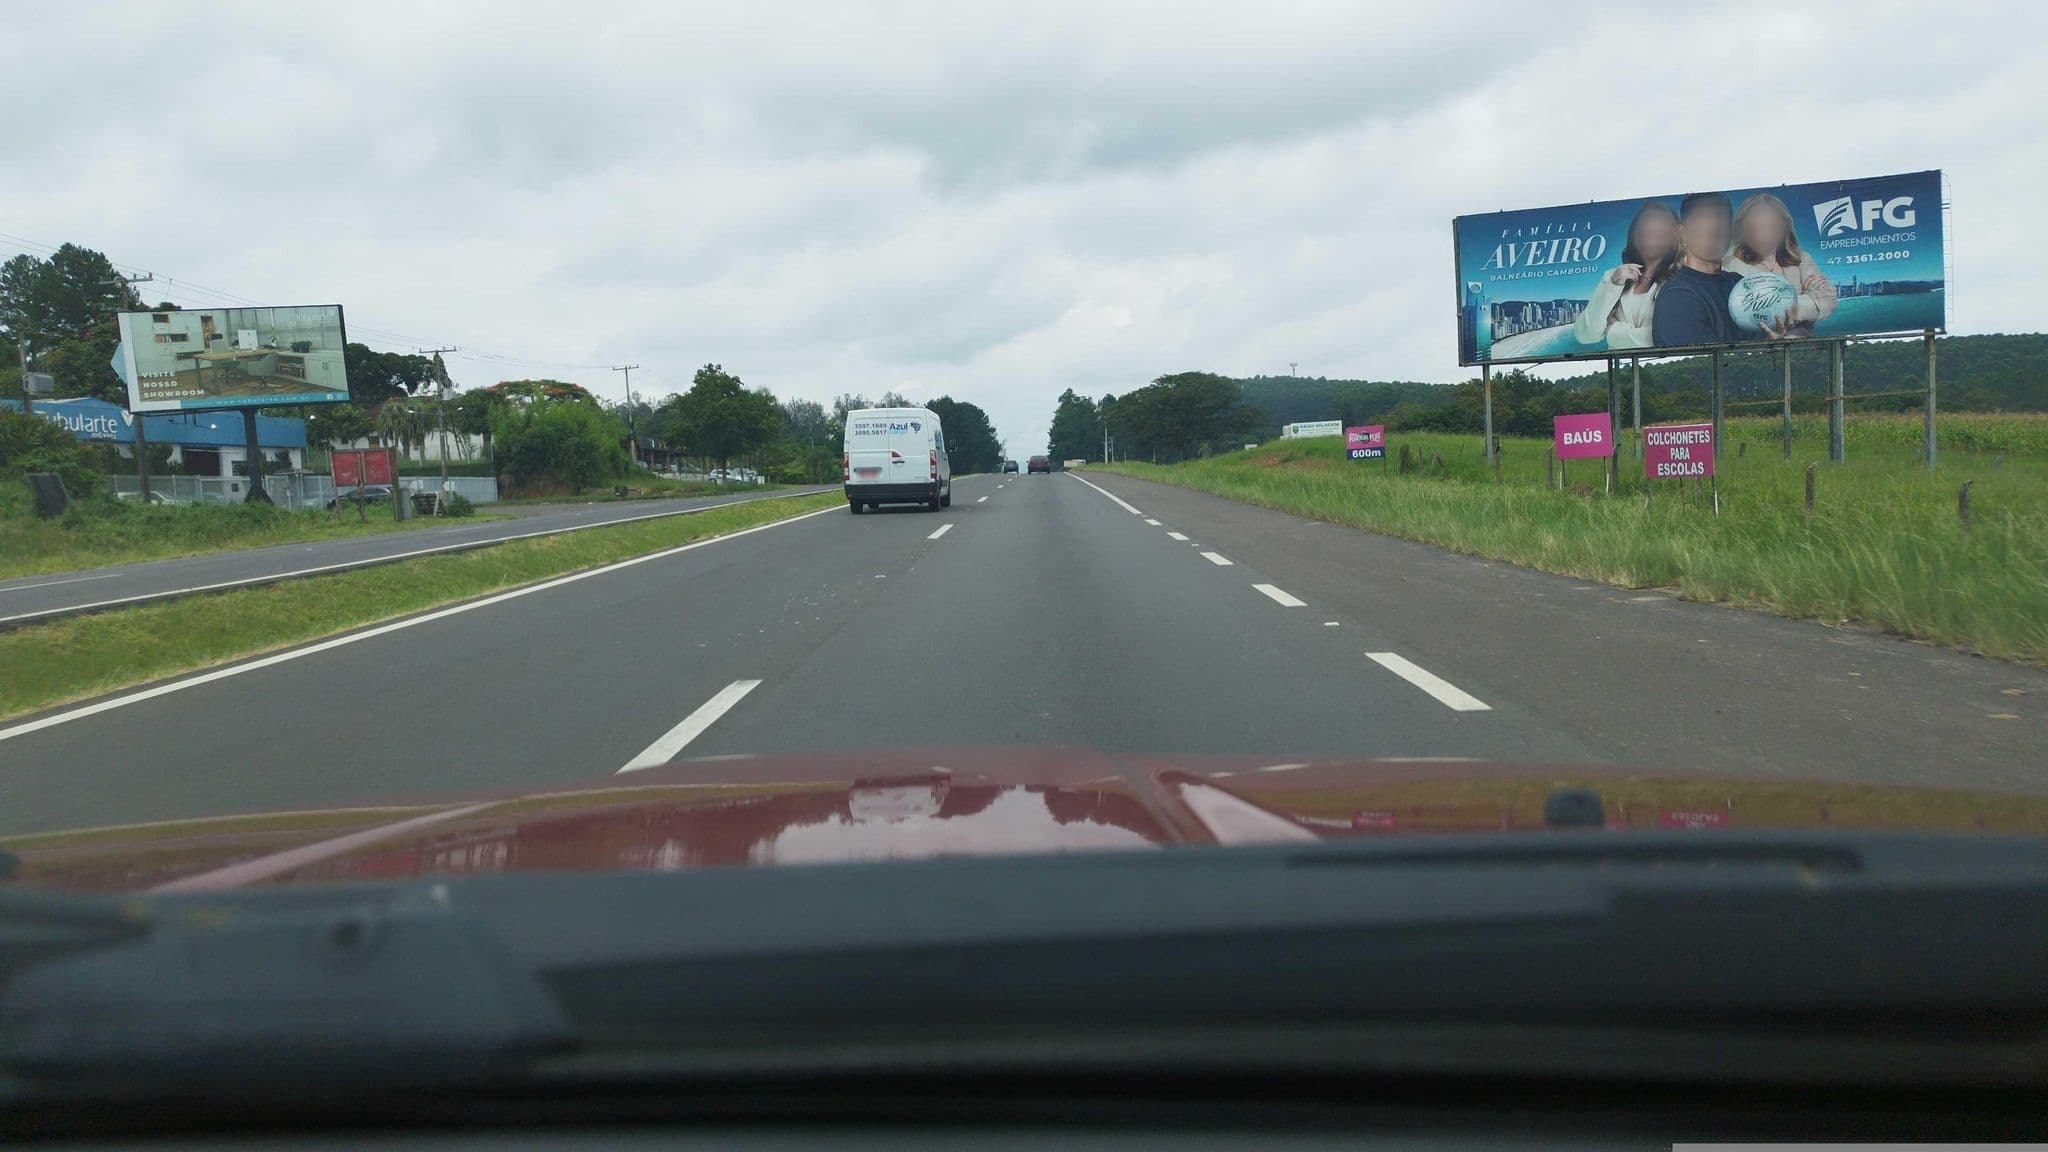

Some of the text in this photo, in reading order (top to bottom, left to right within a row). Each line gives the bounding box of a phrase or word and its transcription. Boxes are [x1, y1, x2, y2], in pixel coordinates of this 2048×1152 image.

[1861, 196, 1916, 231] FG
[1502, 221, 1592, 238] FAMÍLIA
[1820, 231, 1917, 250] EMPREENDIMENTOS
[1480, 234, 1606, 271] AVEIRO
[1827, 250, 1910, 265] 47 3361.2000
[143, 380, 178, 389] NOSSO
[143, 389, 205, 399] SHOWROOM
[889, 422, 908, 430] Azul
[1563, 428, 1603, 445] BAÚS
[1647, 430, 1711, 446] COLCHONETES
[1352, 448, 1381, 458] 600m
[1670, 447, 1691, 461] PARA
[1657, 461, 1705, 476] ESCOLAS
